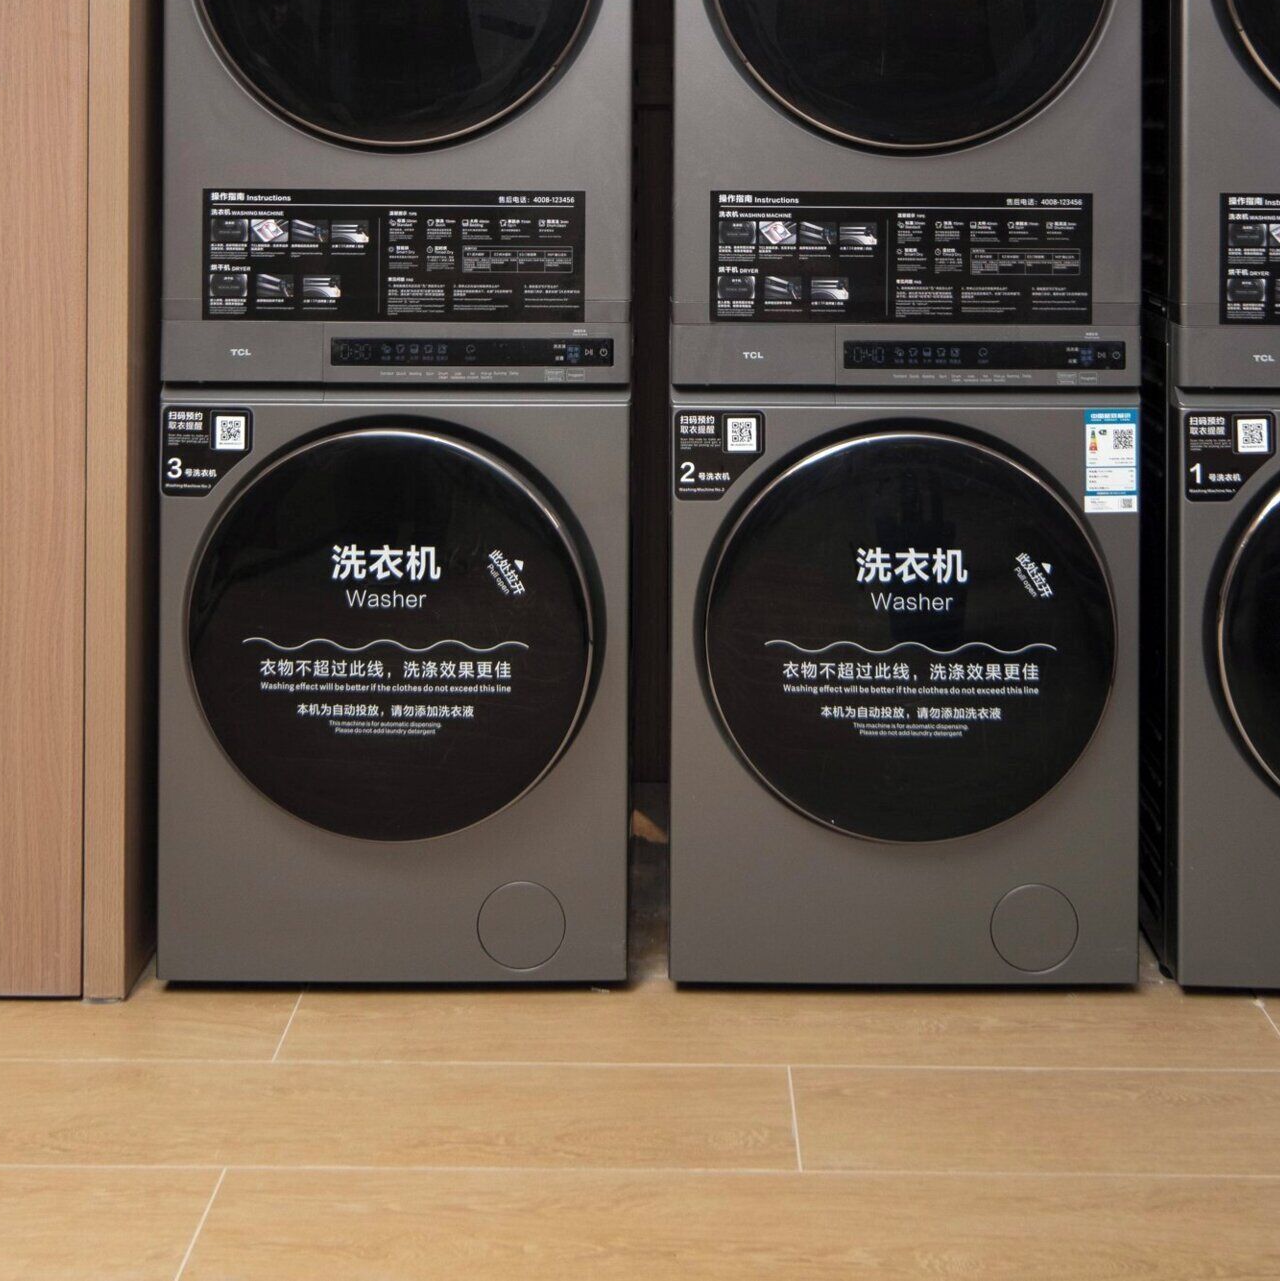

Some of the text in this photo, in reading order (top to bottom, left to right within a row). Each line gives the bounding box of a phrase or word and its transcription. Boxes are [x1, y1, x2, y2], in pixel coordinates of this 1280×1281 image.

[168, 421, 202, 430] 取衣提醒
[169, 412, 203, 422] 扫码预约
[680, 416, 714, 426] 扫码预约
[1189, 417, 1225, 425] 扫码预约
[680, 424, 714, 434] 取衣提醒
[1190, 426, 1225, 435] 取衣提醒
[167, 458, 217, 478] 3 号洗衣机
[680, 462, 730, 482] 2 号洗衣机
[1190, 463, 1241, 483] 1 号洗衣机
[332, 544, 441, 580] 洗衣机
[489, 549, 525, 594] 此处拉开
[856, 547, 968, 583] 洗衣机
[487, 564, 509, 594] Pull open
[1015, 567, 1037, 597] Pull open
[1016, 553, 1053, 597] 此处拉开
[346, 590, 426, 608] Washer
[871, 592, 953, 611] Washer
[260, 659, 511, 678] 衣物不超过此线，洗涤效果更佳
[783, 661, 1039, 680] 衣物不超过此线，洗涤效果更佳
[260, 681, 294, 691] Washing
[295, 681, 318, 690] effect
[319, 682, 333, 690] will
[345, 683, 369, 691] better
[370, 683, 376, 691] if
[377, 683, 390, 691] the
[392, 683, 421, 691] clothes
[423, 684, 433, 692] do
[449, 684, 478, 692] exceed
[479, 684, 494, 692] this
[496, 684, 511, 692] line
[783, 684, 818, 694] Washing
[819, 684, 842, 693] effect
[843, 685, 857, 693] will
[859, 685, 869, 693] be
[870, 685, 894, 693] better
[896, 685, 901, 693] if
[903, 686, 916, 694] the
[918, 686, 948, 694] clothes
[949, 686, 960, 694] do
[976, 686, 1005, 694] exceed
[1006, 686, 1022, 694] this
[1023, 686, 1038, 694] line
